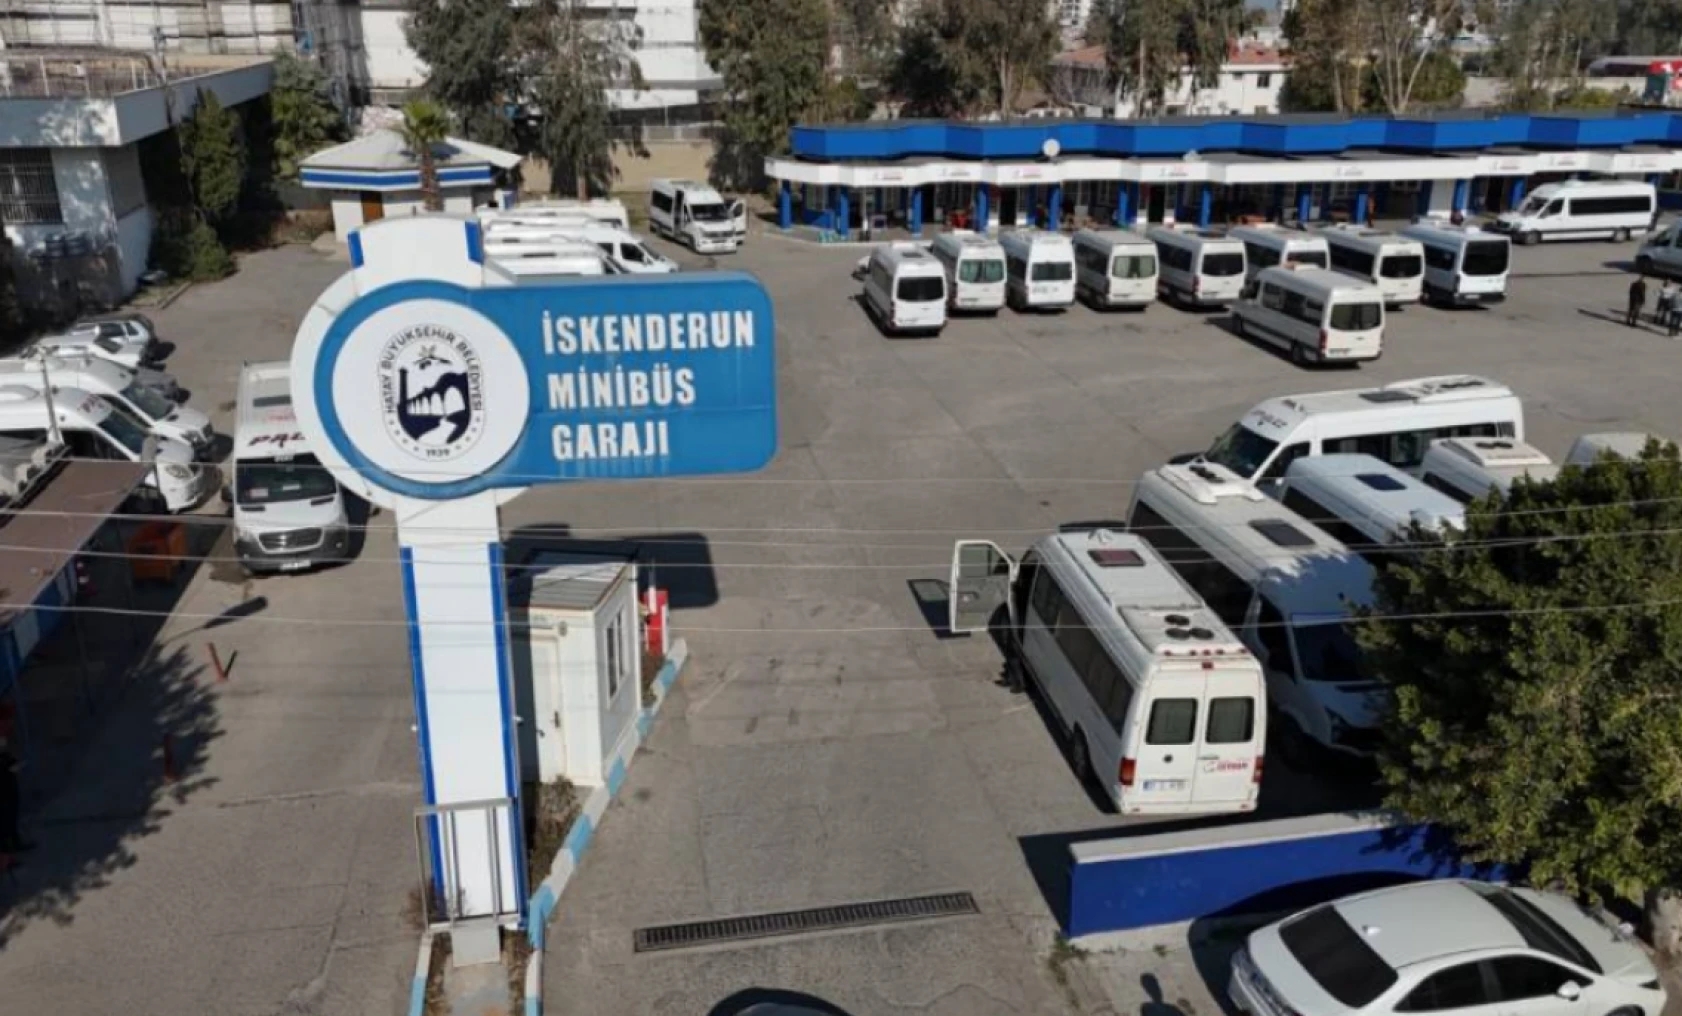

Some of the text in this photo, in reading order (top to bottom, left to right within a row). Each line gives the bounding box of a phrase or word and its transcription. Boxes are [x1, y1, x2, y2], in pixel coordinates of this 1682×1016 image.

[542, 310, 755, 354] İSKENDERUN
[382, 374, 395, 413] HATAY
[548, 362, 696, 410] MİNİBÜS
[552, 419, 670, 460] GARAJI
